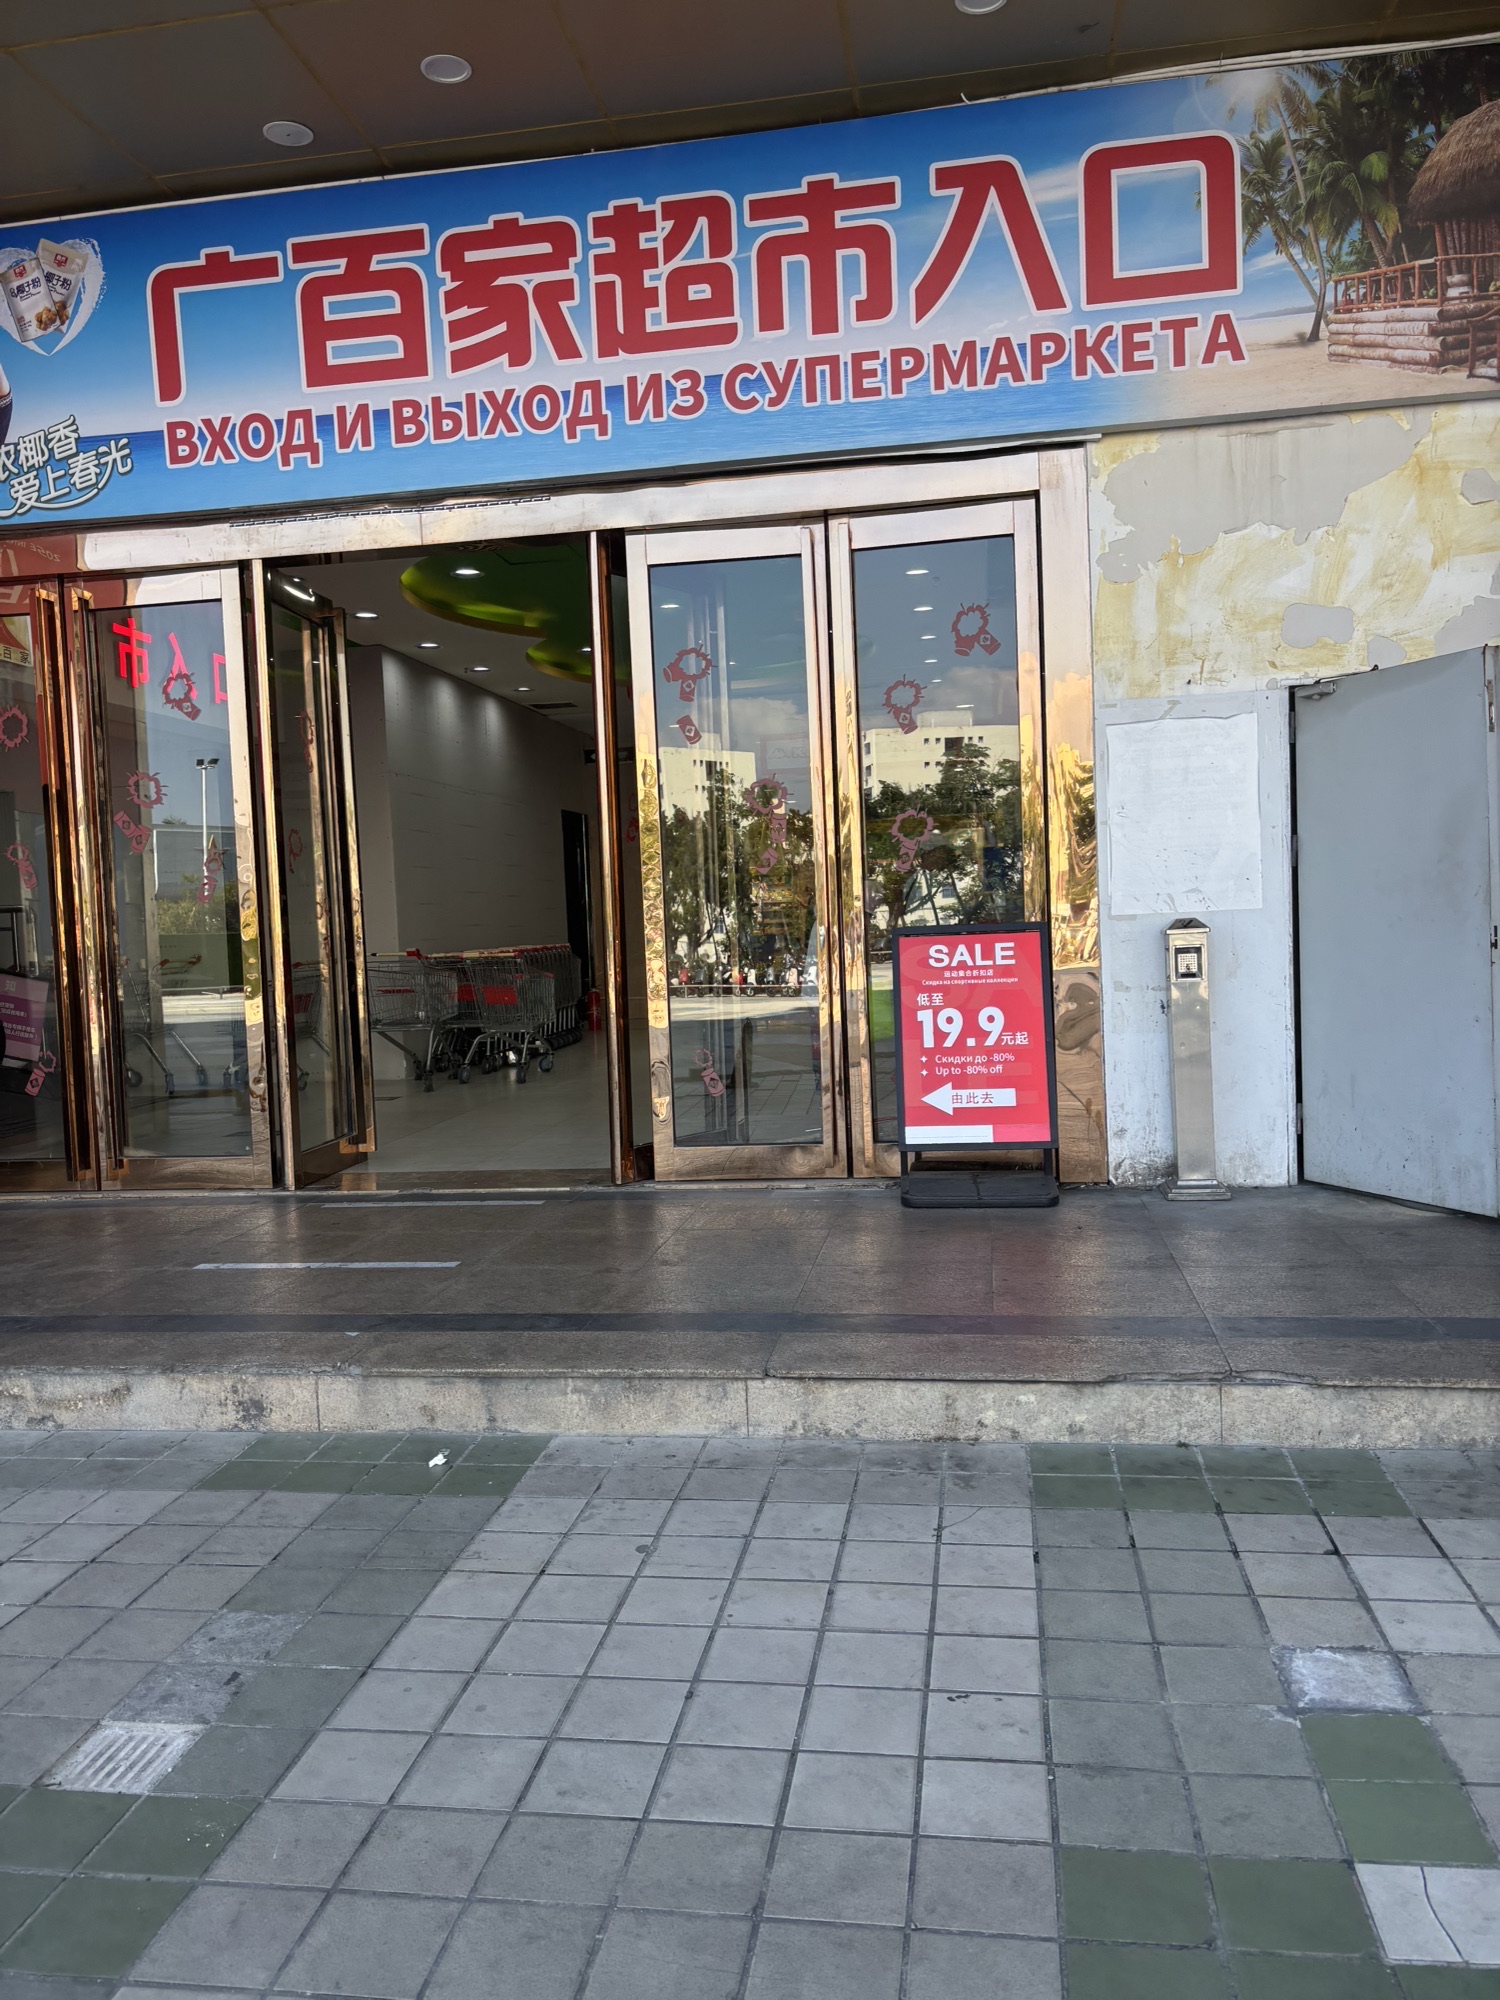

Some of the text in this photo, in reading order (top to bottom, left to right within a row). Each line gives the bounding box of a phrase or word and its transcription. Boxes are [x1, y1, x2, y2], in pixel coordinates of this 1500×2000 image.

[148, 134, 1240, 403] 广百家超市入口
[166, 314, 1245, 467] ВХОД И ВЫХОД ИЗ СУПЕРМАРКЕТА
[9, 437, 133, 515] 爱上春光
[928, 941, 1016, 968] SALE
[916, 993, 944, 1007] 低至
[916, 1006, 1005, 1049] 19.9
[935, 1052, 1016, 1064] Скидки до -80%
[935, 1064, 1004, 1077] Up to -80% off
[951, 1091, 995, 1105] 由此去
